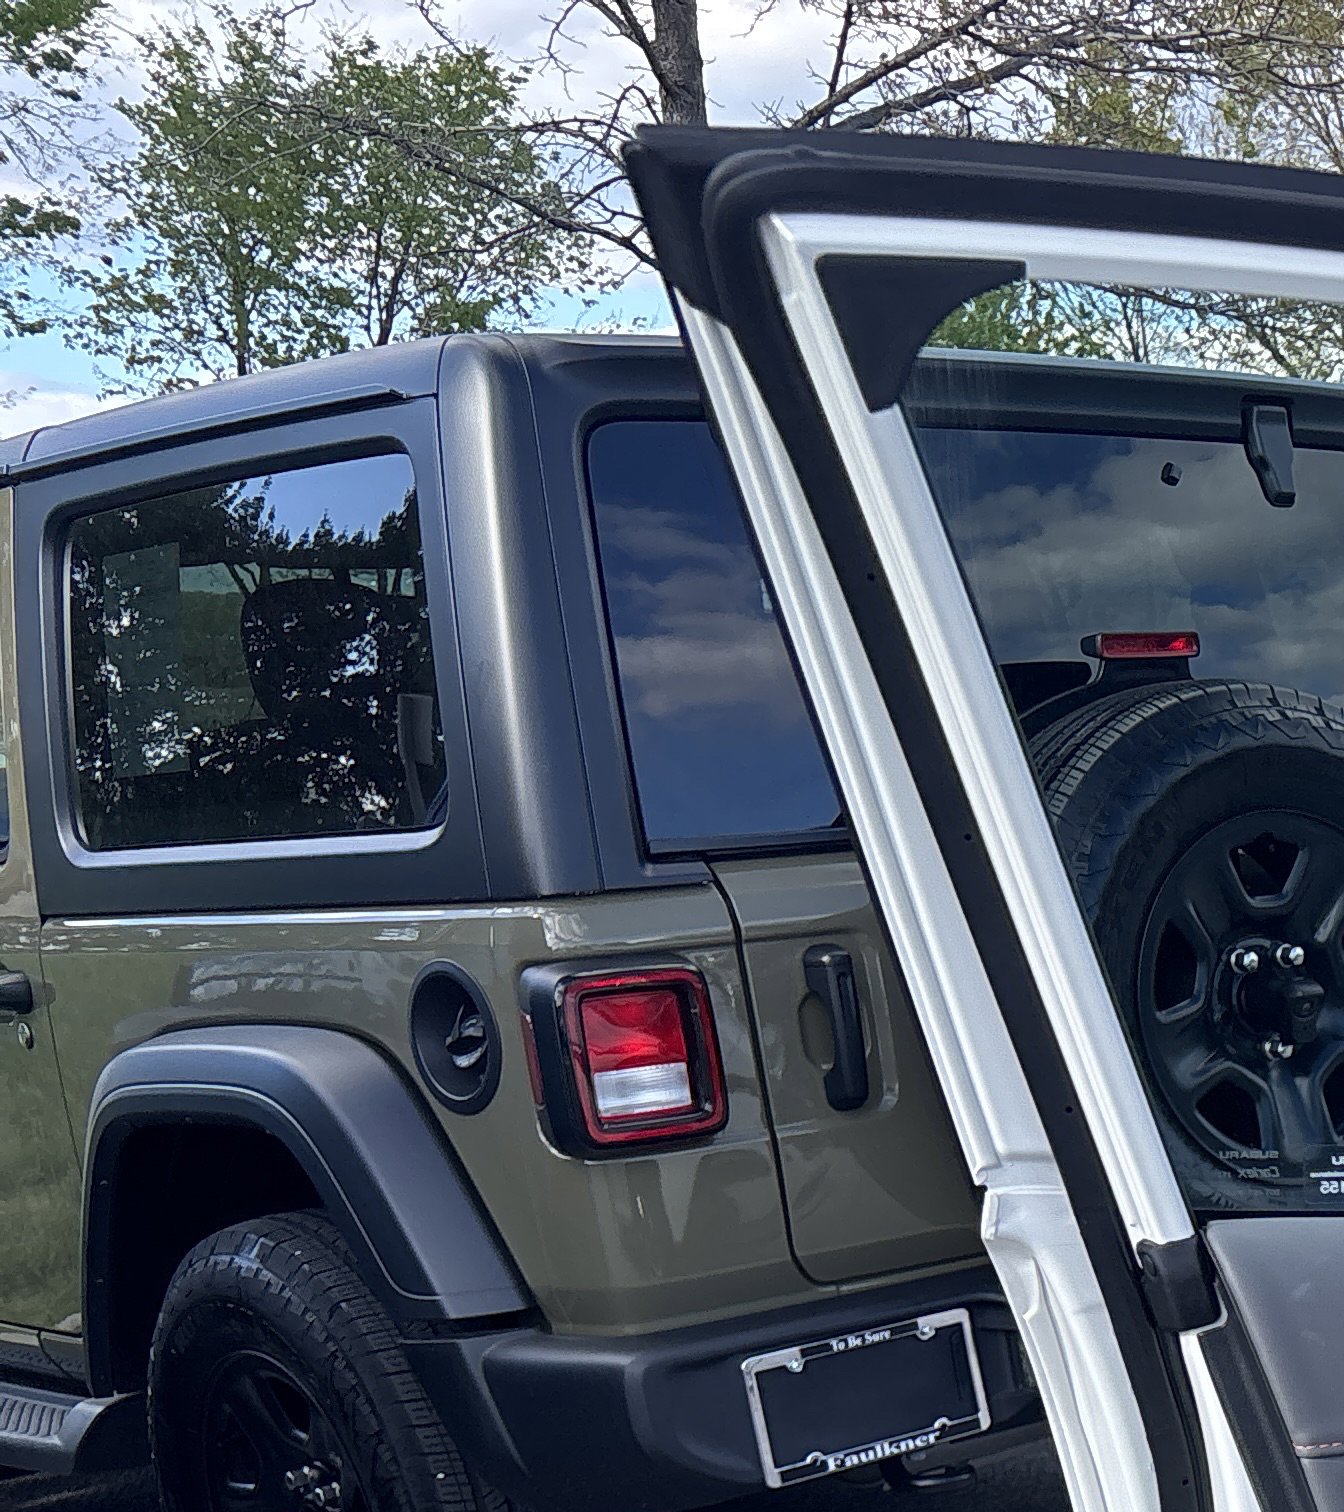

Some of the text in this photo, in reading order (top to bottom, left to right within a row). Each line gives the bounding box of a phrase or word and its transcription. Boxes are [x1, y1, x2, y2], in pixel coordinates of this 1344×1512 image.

[829, 1329, 891, 1352] To Be Sure
[823, 1430, 943, 1473] Faulkner
